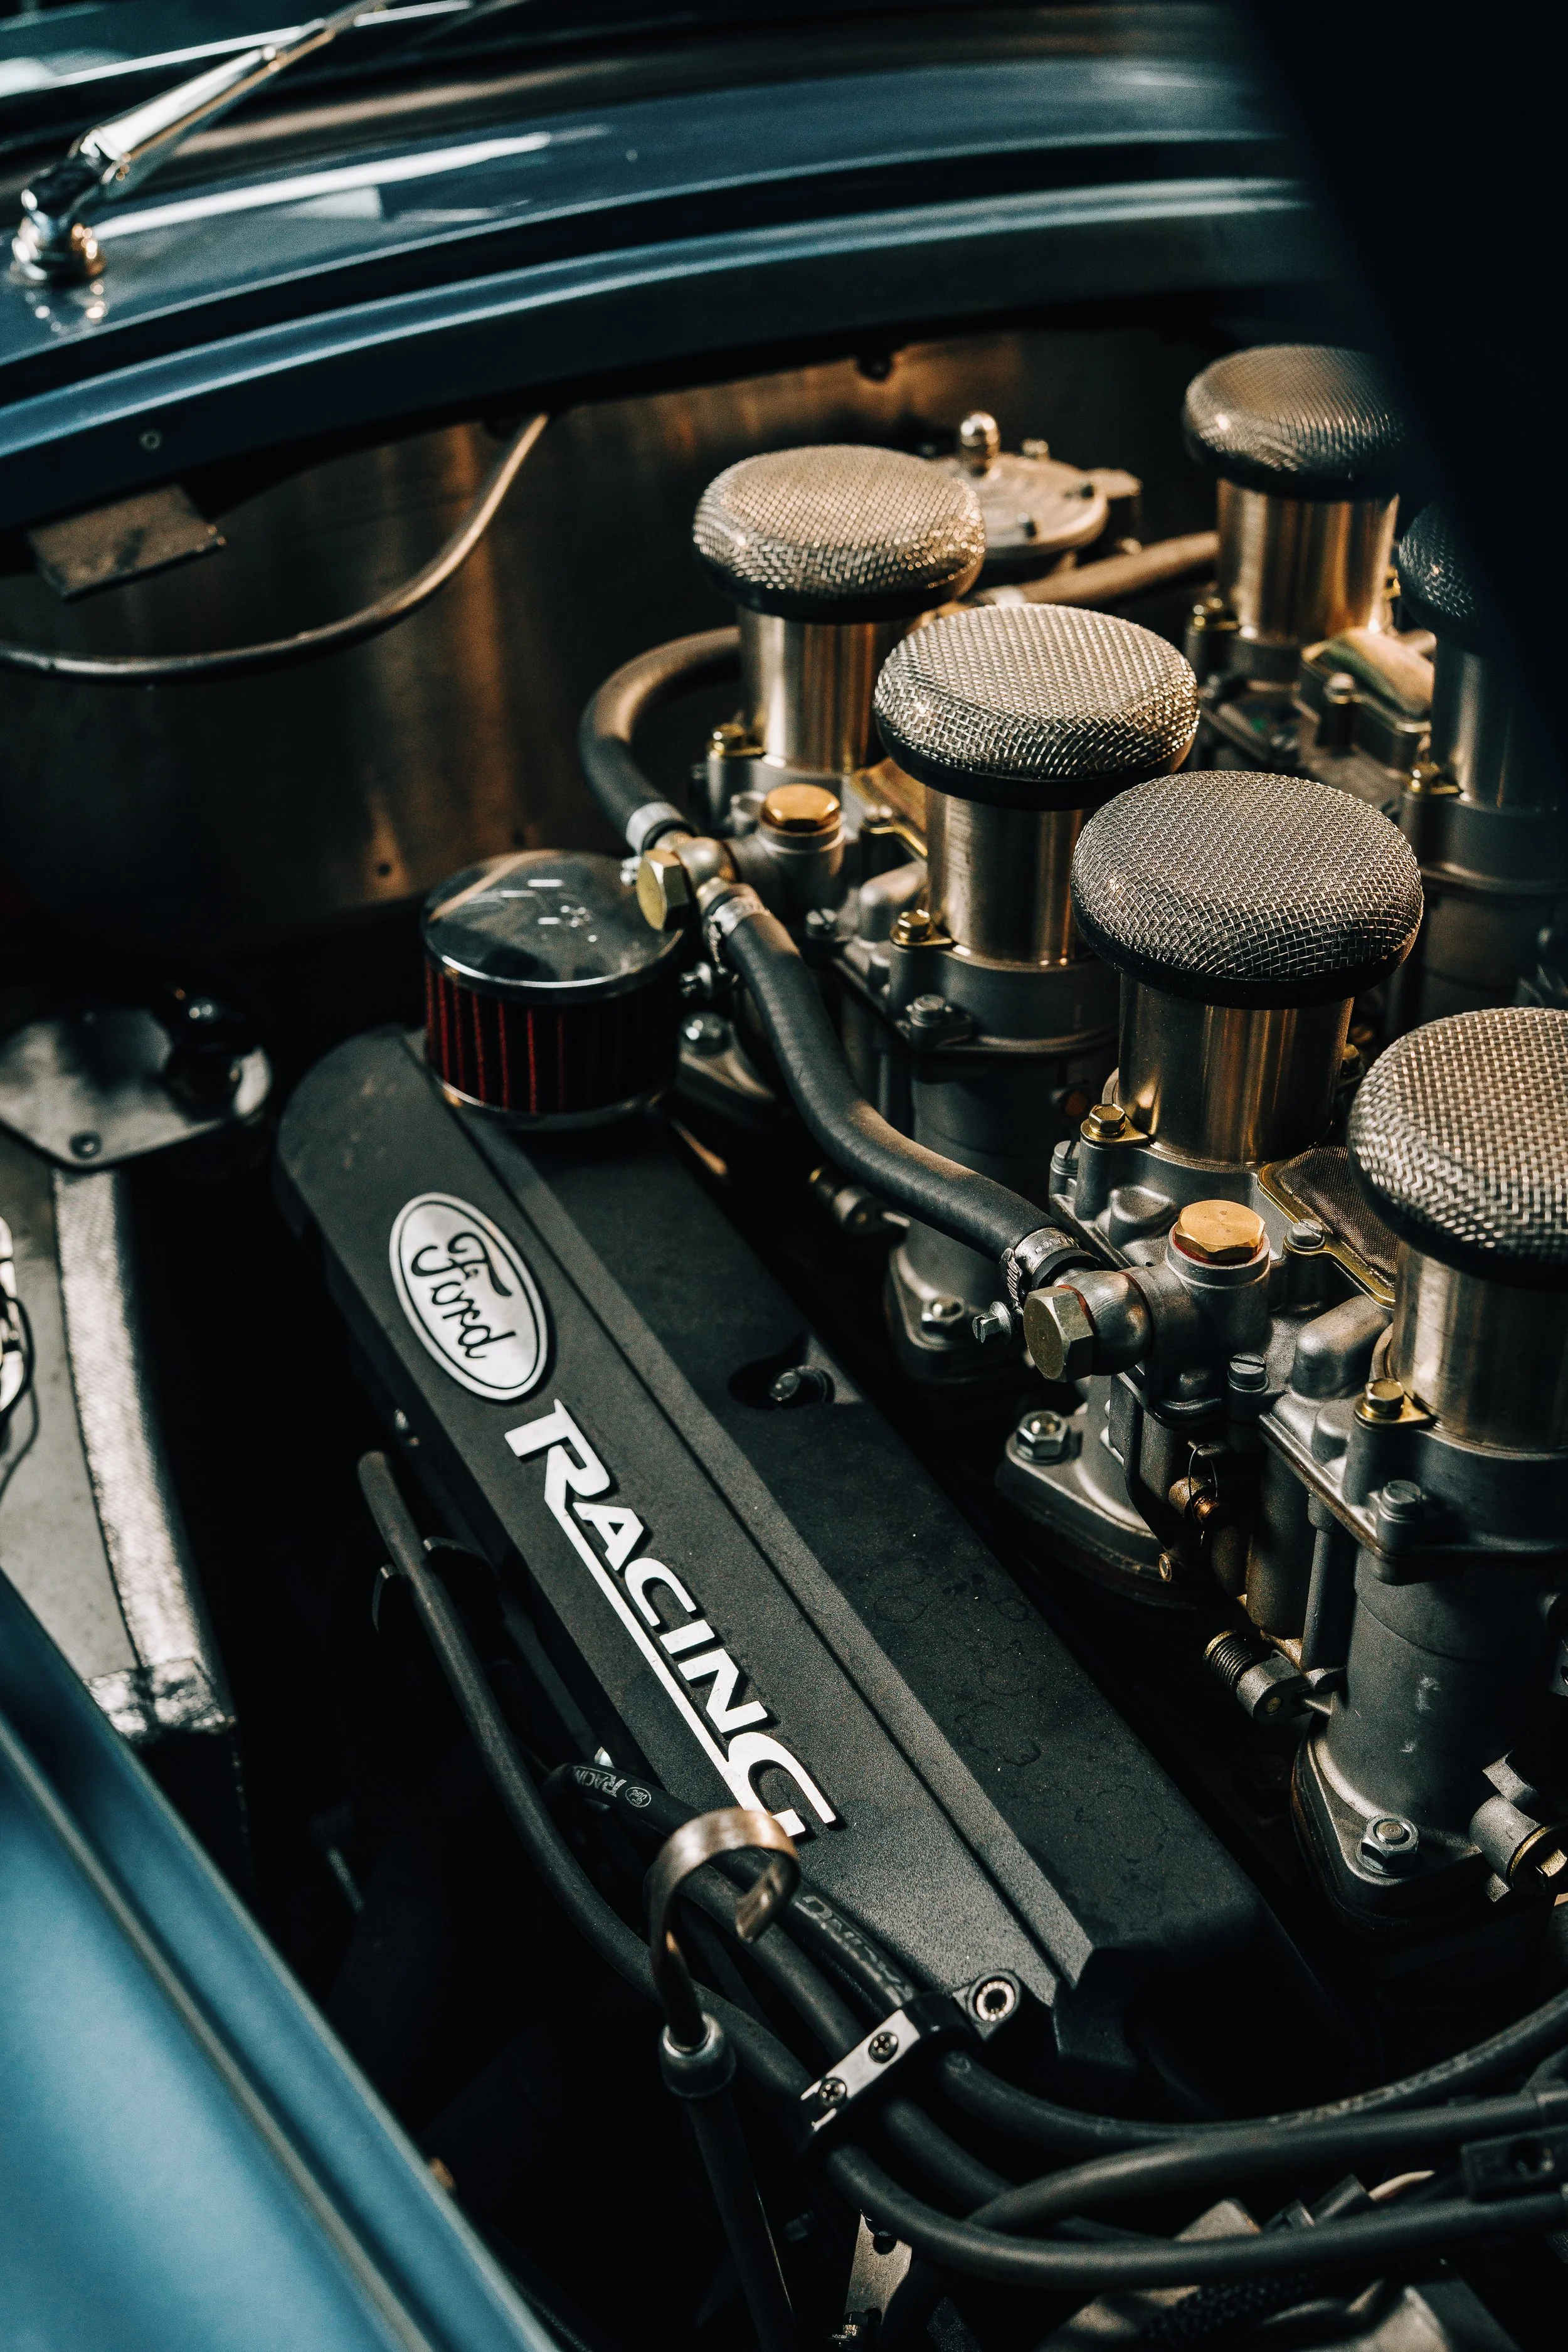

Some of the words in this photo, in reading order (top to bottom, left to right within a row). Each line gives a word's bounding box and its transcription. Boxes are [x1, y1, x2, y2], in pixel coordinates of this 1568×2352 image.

[411, 1232, 516, 1359] Ford
[504, 1399, 837, 1837] RACING
[572, 1765, 627, 1798] RACIN
